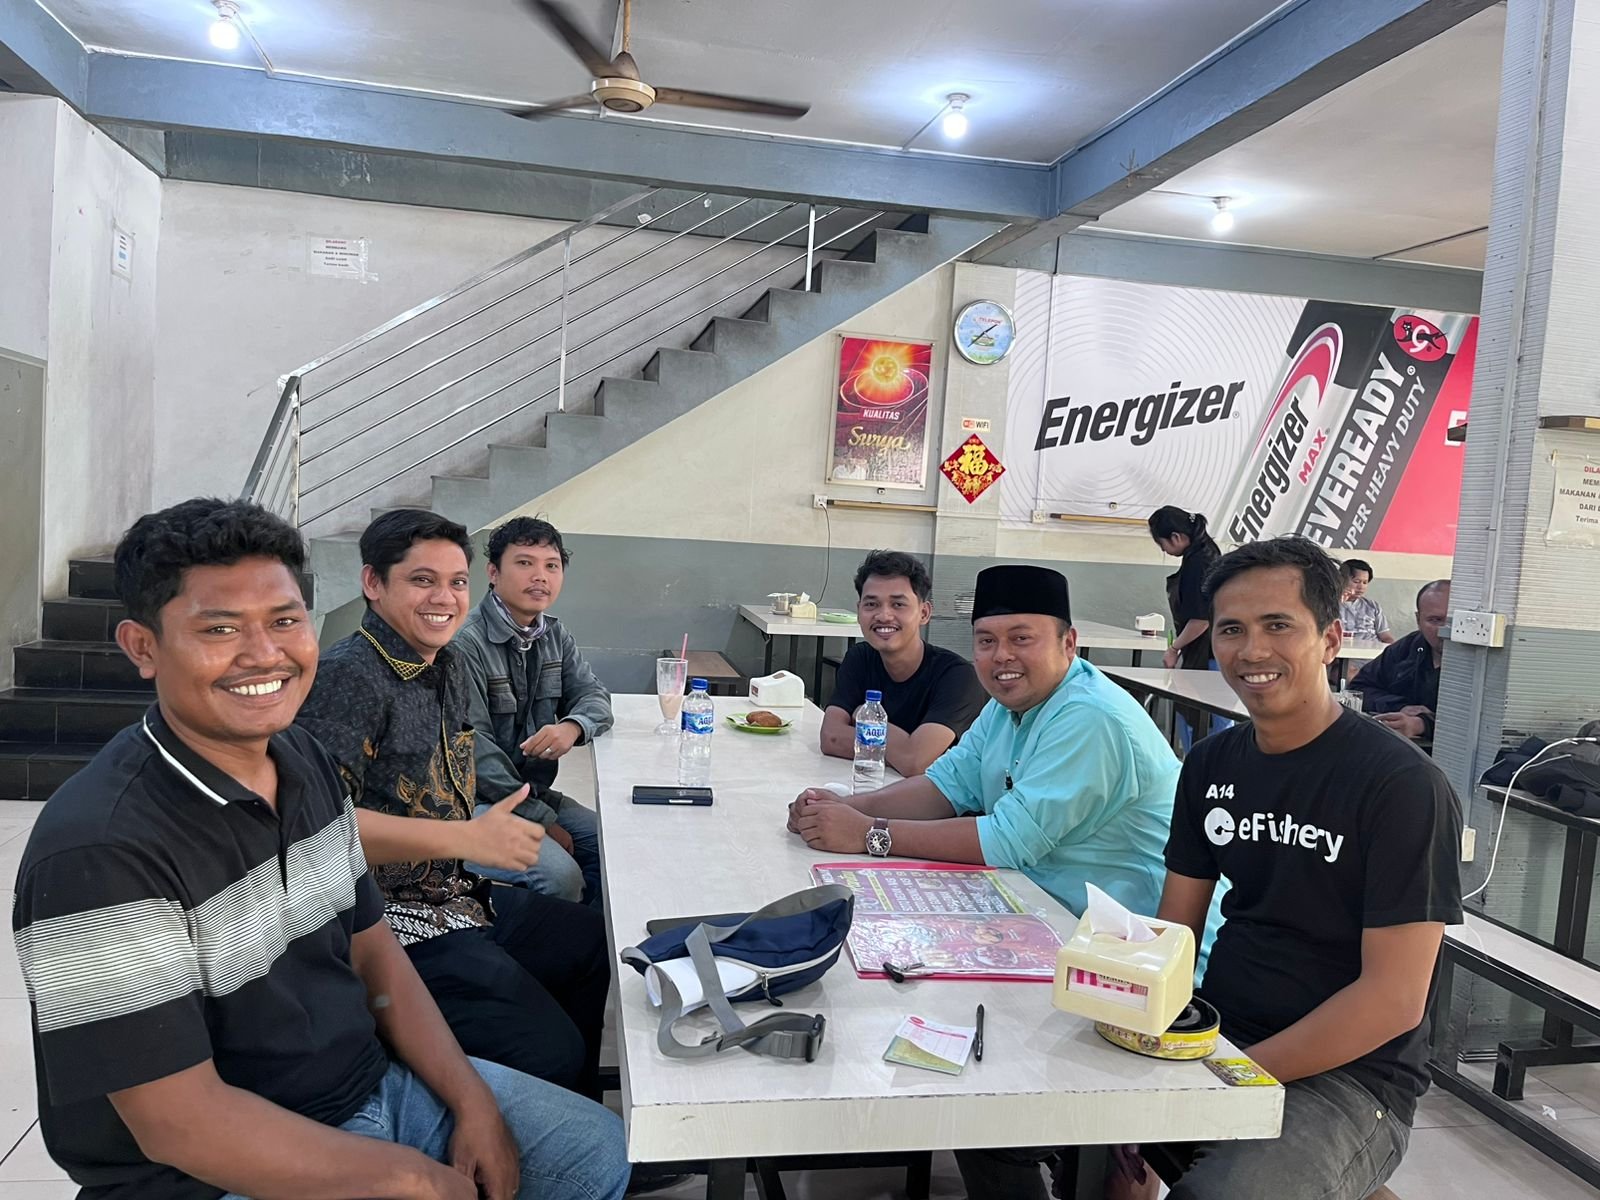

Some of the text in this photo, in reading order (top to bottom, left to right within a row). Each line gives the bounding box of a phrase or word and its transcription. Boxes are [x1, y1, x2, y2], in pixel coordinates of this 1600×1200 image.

[863, 409, 900, 420] KUALITAS
[1034, 381, 1245, 451] Energizer
[848, 425, 911, 456] Surya
[1301, 352, 1404, 548] EVEREADY
[1365, 433, 1401, 503] HEAVY
[1396, 376, 1426, 437] DUTY
[957, 444, 989, 476] 福
[1229, 396, 1309, 542] Energizer
[1300, 431, 1326, 484] MAX
[1560, 488, 1596, 499] MAKANAN
[1579, 503, 1596, 511] DARI
[1576, 515, 1599, 524] Terima
[1205, 784, 1235, 799] A14
